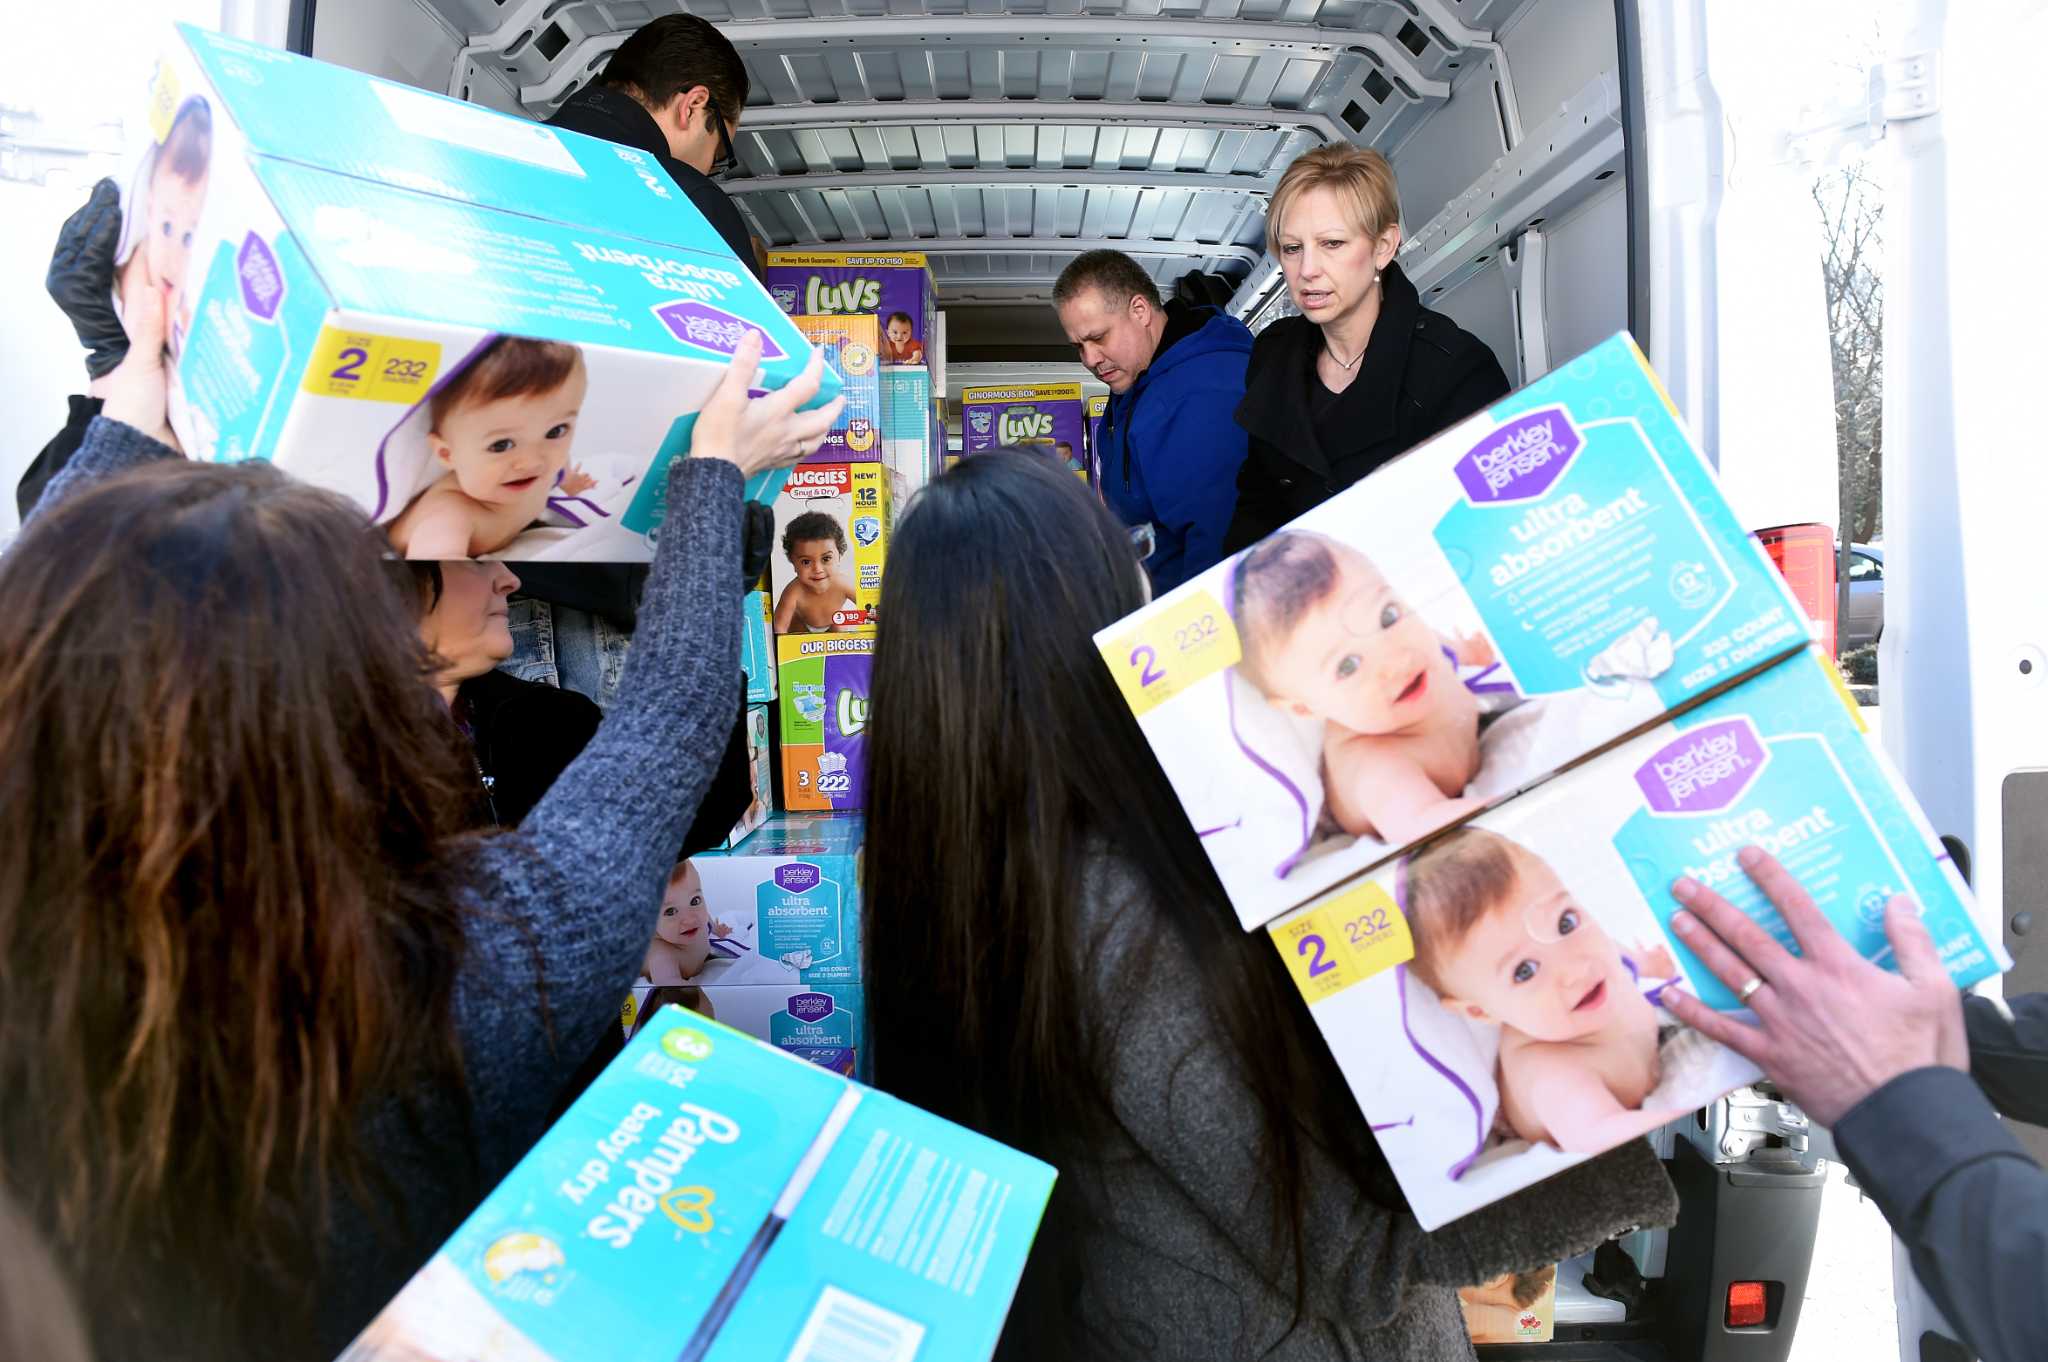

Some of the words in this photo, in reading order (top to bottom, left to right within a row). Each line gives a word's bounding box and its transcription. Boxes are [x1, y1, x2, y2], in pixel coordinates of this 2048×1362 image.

[572, 241, 744, 289] absorbent
[846, 256, 865, 265] SAVE
[865, 256, 875, 265] UP
[876, 256, 885, 265] TO
[642, 269, 726, 300] ultra
[806, 276, 881, 315] Luvs
[331, 347, 369, 382] 2
[384, 357, 429, 379] 232
[968, 390, 1017, 400] GINORMOUS
[1018, 389, 1035, 398] BOX
[851, 421, 869, 431] 124
[998, 411, 1053, 446] Luvs
[1472, 418, 1555, 474] berkley
[794, 489, 813, 497] Snug
[820, 488, 836, 497] Dry
[857, 487, 877, 501] 12
[1507, 492, 1589, 543] ultra
[1488, 486, 1648, 587] absorbent
[801, 642, 824, 654] OUR
[826, 639, 875, 652] BIGGEST
[1173, 613, 1221, 652] 232
[1129, 643, 1167, 689] 2
[1653, 728, 1739, 782] berkley
[799, 771, 810, 786] 3
[818, 775, 850, 792] 222
[1683, 804, 1835, 886] bsobent
[1690, 805, 1773, 857] ultra
[782, 866, 814, 877] berkley
[768, 906, 828, 916] absorbent
[782, 895, 810, 906] ultra
[1343, 906, 1394, 946] 232
[1296, 933, 1338, 979] 2
[796, 996, 827, 1006] berkley
[674, 1033, 711, 1059] 3
[782, 1035, 842, 1045] absorbent
[796, 1025, 823, 1035] ultra
[596, 1101, 663, 1163] baby
[560, 1158, 611, 1205] dry
[586, 1101, 741, 1250] Pampers
